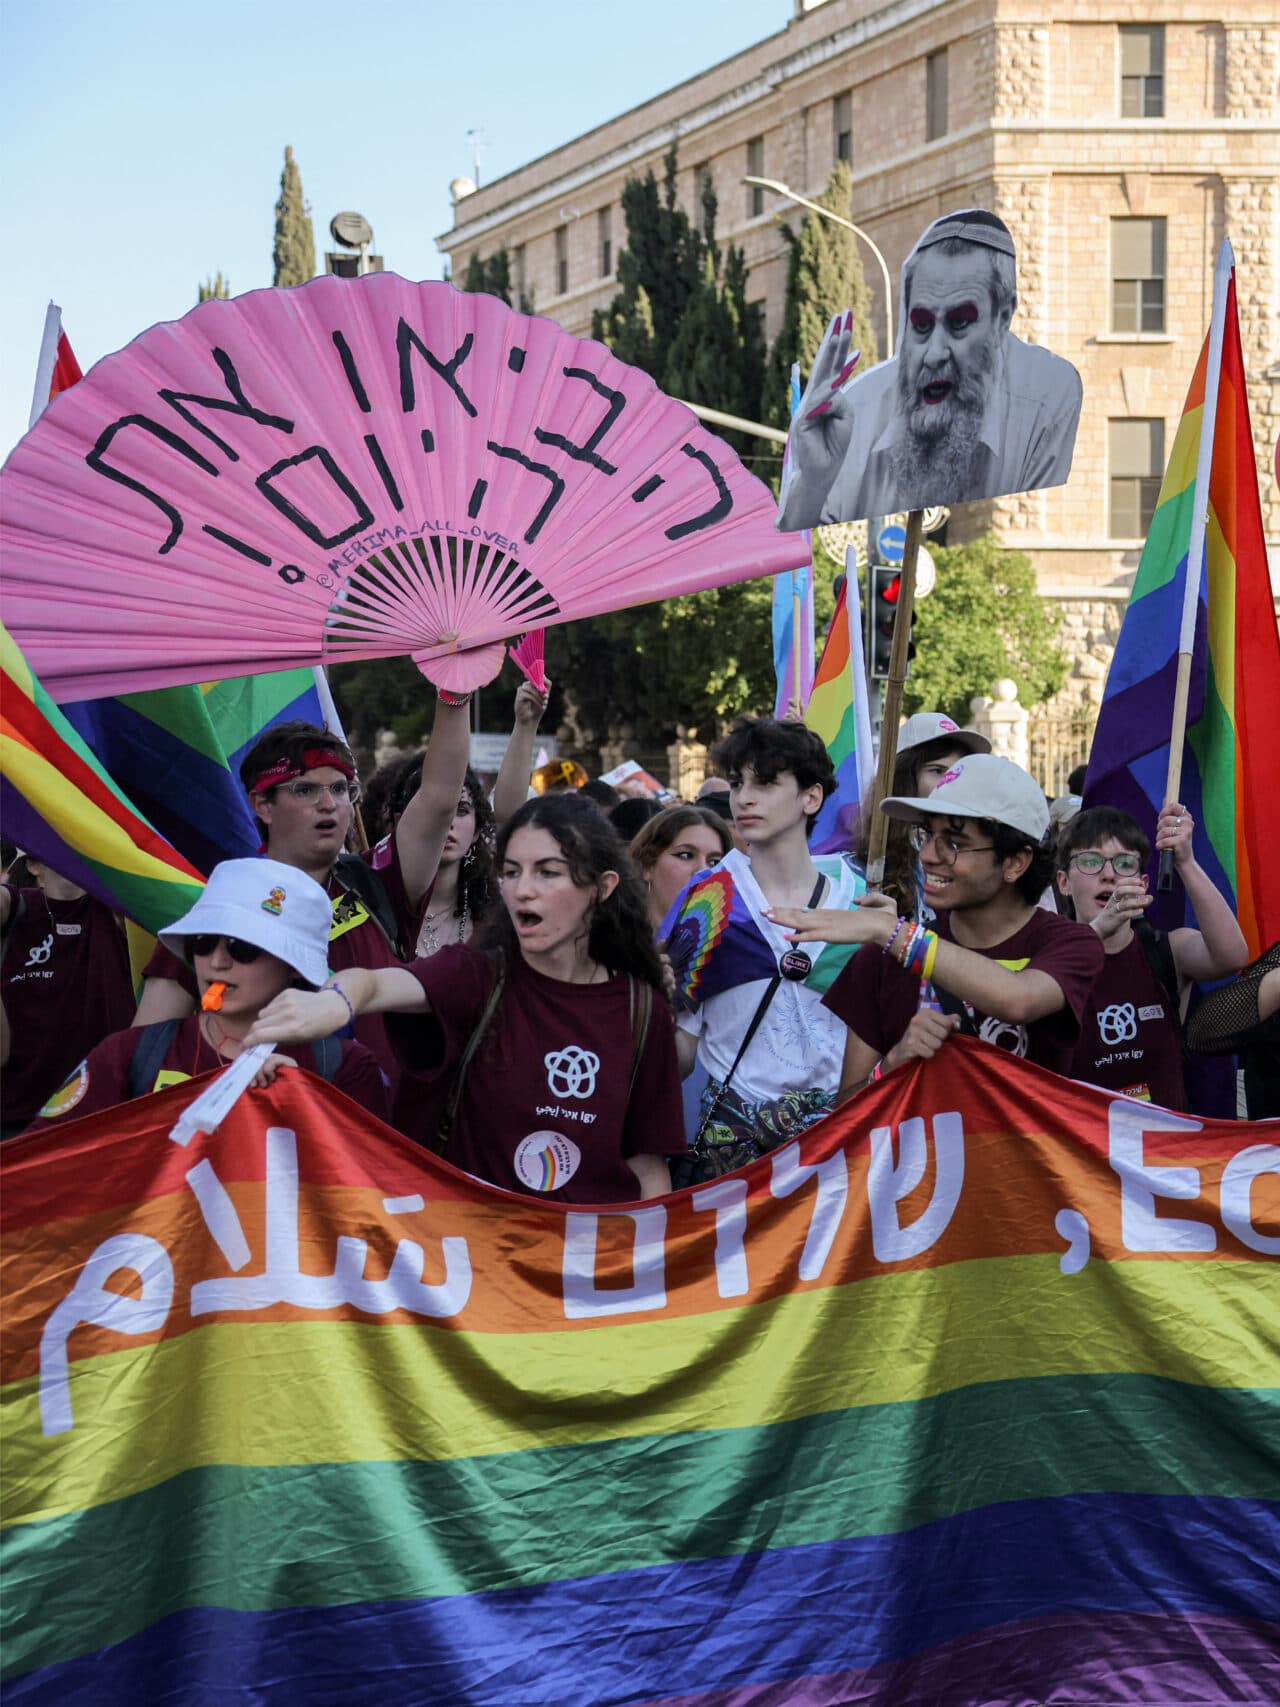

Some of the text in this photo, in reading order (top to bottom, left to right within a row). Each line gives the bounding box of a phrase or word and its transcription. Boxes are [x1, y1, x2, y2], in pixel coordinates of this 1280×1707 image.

[1131, 1049, 1144, 1059] Igy
[580, 1111, 597, 1124] Igy
[562, 1110, 965, 1319] שלום
